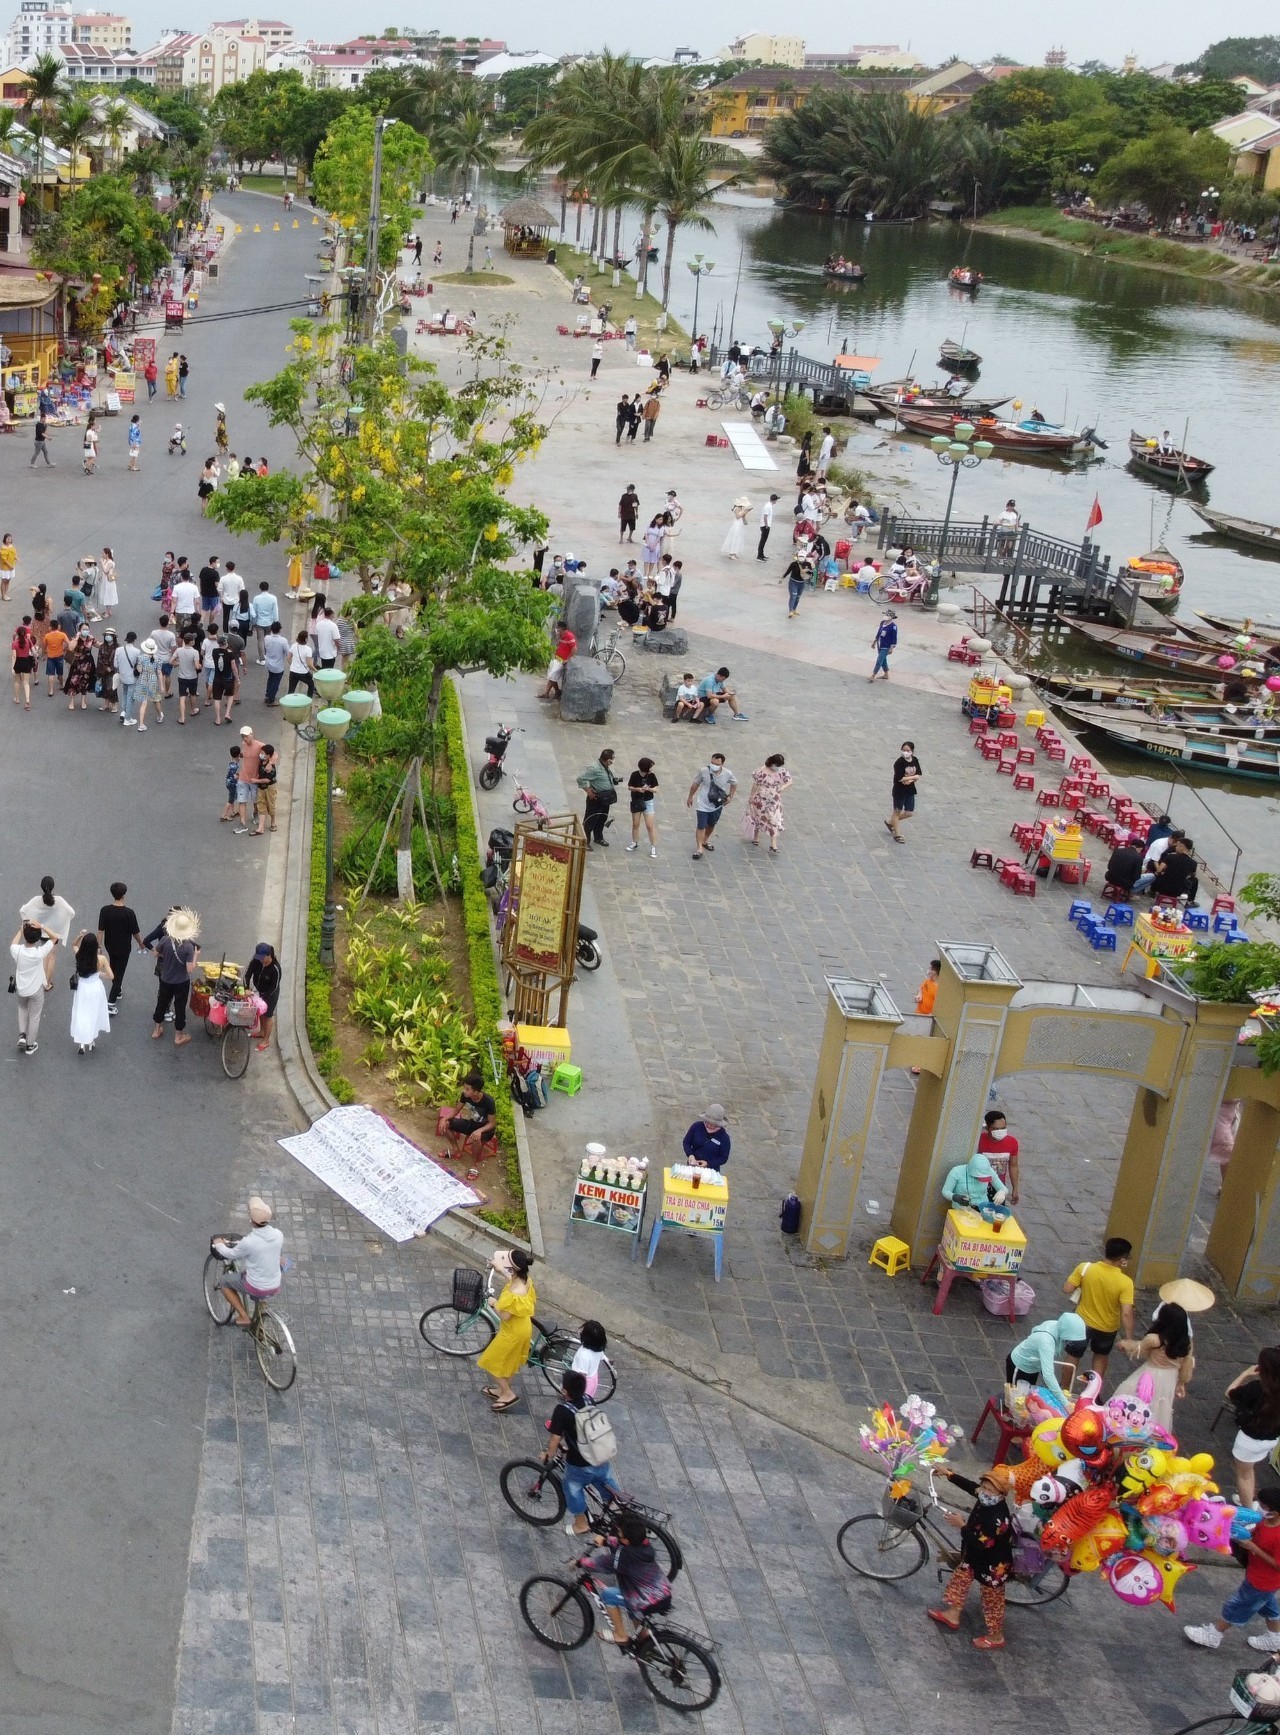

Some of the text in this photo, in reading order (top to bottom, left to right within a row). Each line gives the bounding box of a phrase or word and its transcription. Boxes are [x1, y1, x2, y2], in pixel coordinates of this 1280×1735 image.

[1147, 743, 1180, 757] 018HA
[534, 860, 558, 873] 2016
[578, 1183, 639, 1207] KEM KHÓI
[697, 1200, 710, 1211] CHIA
[714, 1206, 726, 1215] 10K
[712, 1218, 724, 1227] 15K
[992, 1244, 1006, 1254] CHIA
[1011, 1248, 1023, 1257] 10K
[1008, 1261, 1019, 1270] 15K
